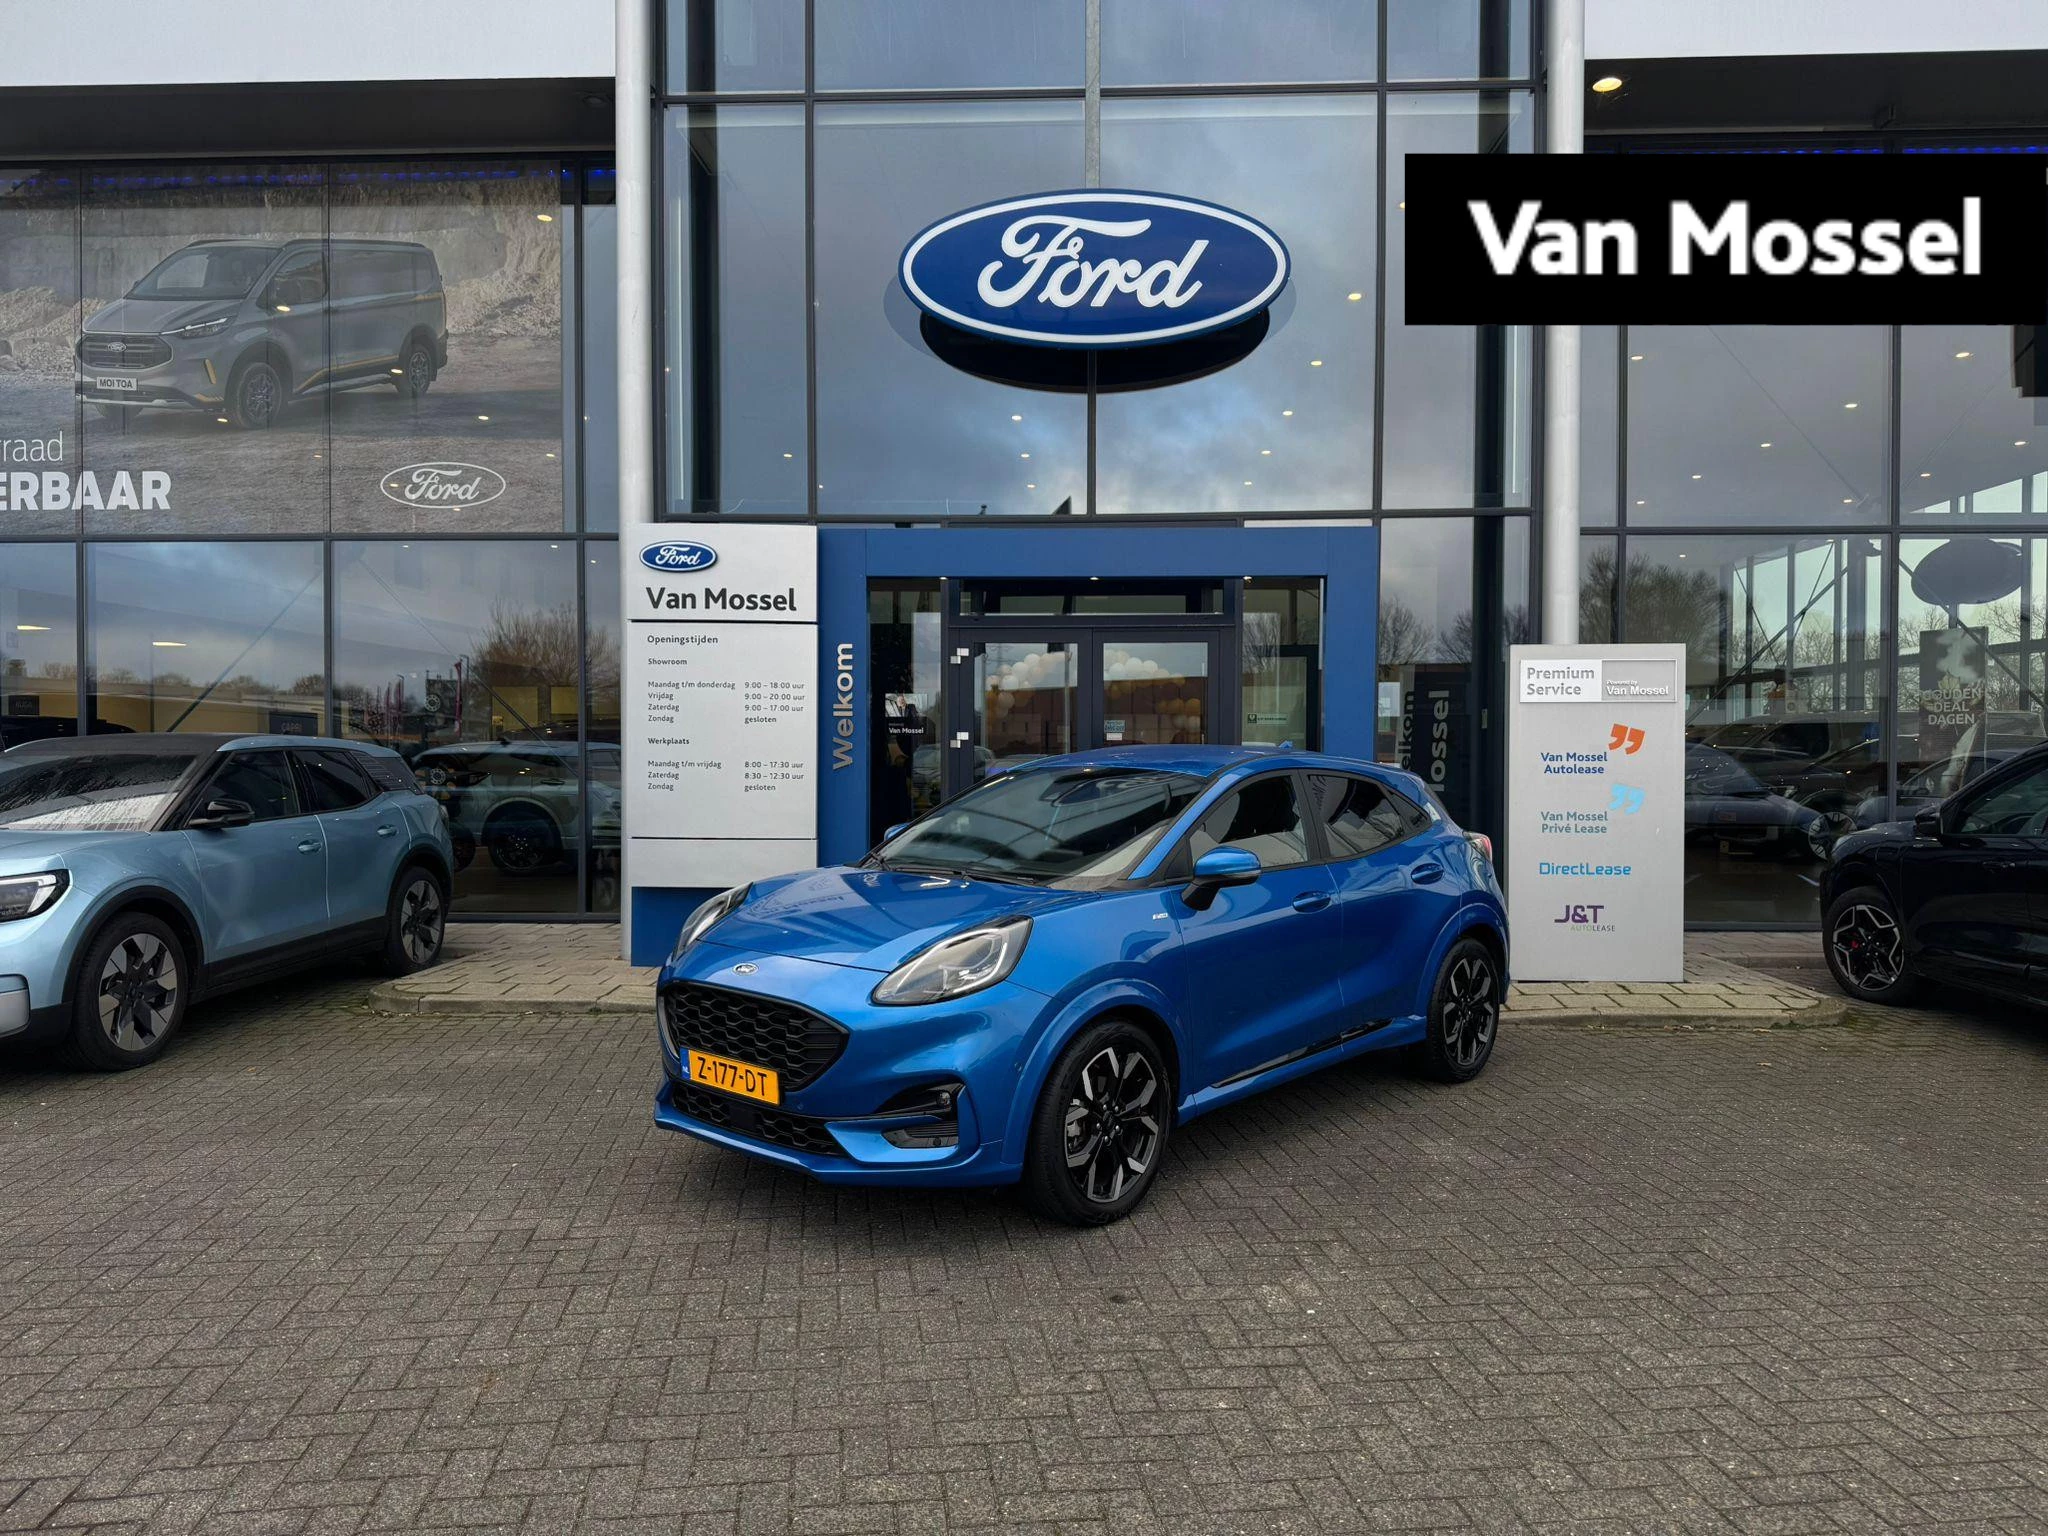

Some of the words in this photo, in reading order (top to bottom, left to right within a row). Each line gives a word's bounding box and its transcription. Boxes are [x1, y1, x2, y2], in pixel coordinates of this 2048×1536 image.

[977, 215, 1210, 308] Ford
[0, 430, 63, 462] raad
[404, 468, 482, 500] Ford
[655, 547, 701, 566] Ford
[646, 587, 697, 610] Van
[704, 588, 797, 612] Mossel
[647, 635, 719, 645] Openingstijden
[1526, 666, 1595, 680] Premium
[648, 681, 680, 689] Maandag
[697, 681, 736, 690] donderdag
[1526, 682, 1582, 696] Service
[1606, 686, 1627, 695] Van
[1630, 685, 1669, 696] Mossel
[648, 692, 674, 701] Vrijdag
[648, 703, 680, 712] Zaterdag
[832, 643, 854, 771] Welkom
[1934, 702, 1970, 712] DEAL
[648, 714, 674, 723] Zondag
[744, 716, 777, 724] gesloten
[1927, 713, 1975, 725] DAGEN
[1397, 690, 1416, 771] elkom
[647, 737, 690, 746] Werkplaats
[1540, 752, 1563, 762] Van
[1566, 751, 1608, 762] Mossel
[648, 760, 680, 769] Maandag
[696, 760, 722, 769] vrijdag
[1544, 764, 1605, 774] Autolease
[648, 771, 680, 780] Zaterdag
[648, 782, 674, 791] Zondag
[744, 784, 776, 792] gesloten
[1540, 811, 1563, 821] Van
[1566, 811, 1608, 821] Mossel
[1541, 823, 1572, 834] Privé
[1574, 823, 1608, 834] Lease
[1539, 862, 1632, 875] DirectLease
[1554, 904, 1605, 924] J&T
[1570, 924, 1616, 932] AUTOLEASE
[697, 1056, 768, 1097] Z-177-DT
